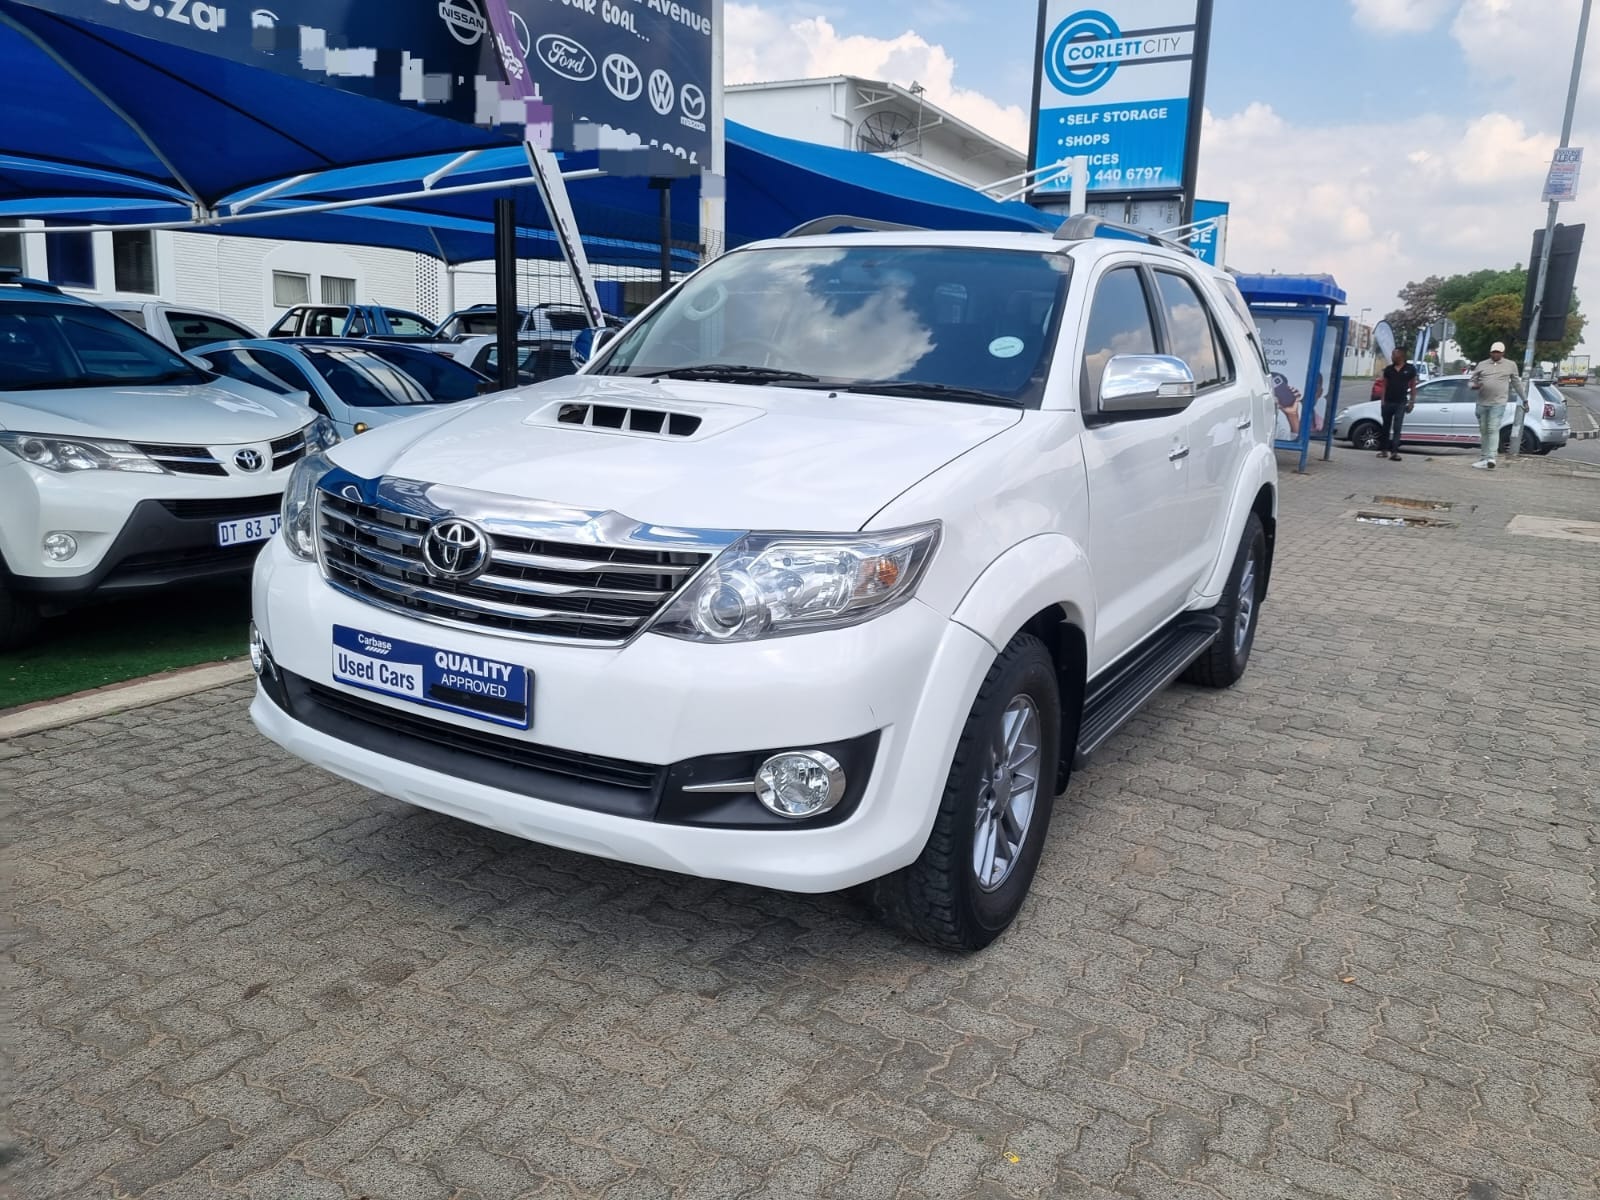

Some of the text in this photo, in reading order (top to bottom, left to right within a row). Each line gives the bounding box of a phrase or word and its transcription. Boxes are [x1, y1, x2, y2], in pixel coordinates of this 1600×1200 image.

[441, 6, 485, 30] NISSAN
[647, 0, 712, 35] Avenue
[547, 40, 586, 75] Ford
[1066, 108, 1168, 125] SELF STORAGE
[1065, 133, 1110, 146] SHOPS
[1094, 168, 1122, 181] 440
[1125, 167, 1163, 181] 6797
[221, 523, 238, 543] DT
[245, 520, 262, 538] 83
[358, 633, 393, 651] Carbase
[338, 652, 416, 692] Used Cars
[434, 651, 513, 682] QUALITY
[440, 673, 508, 698] APPROVED
